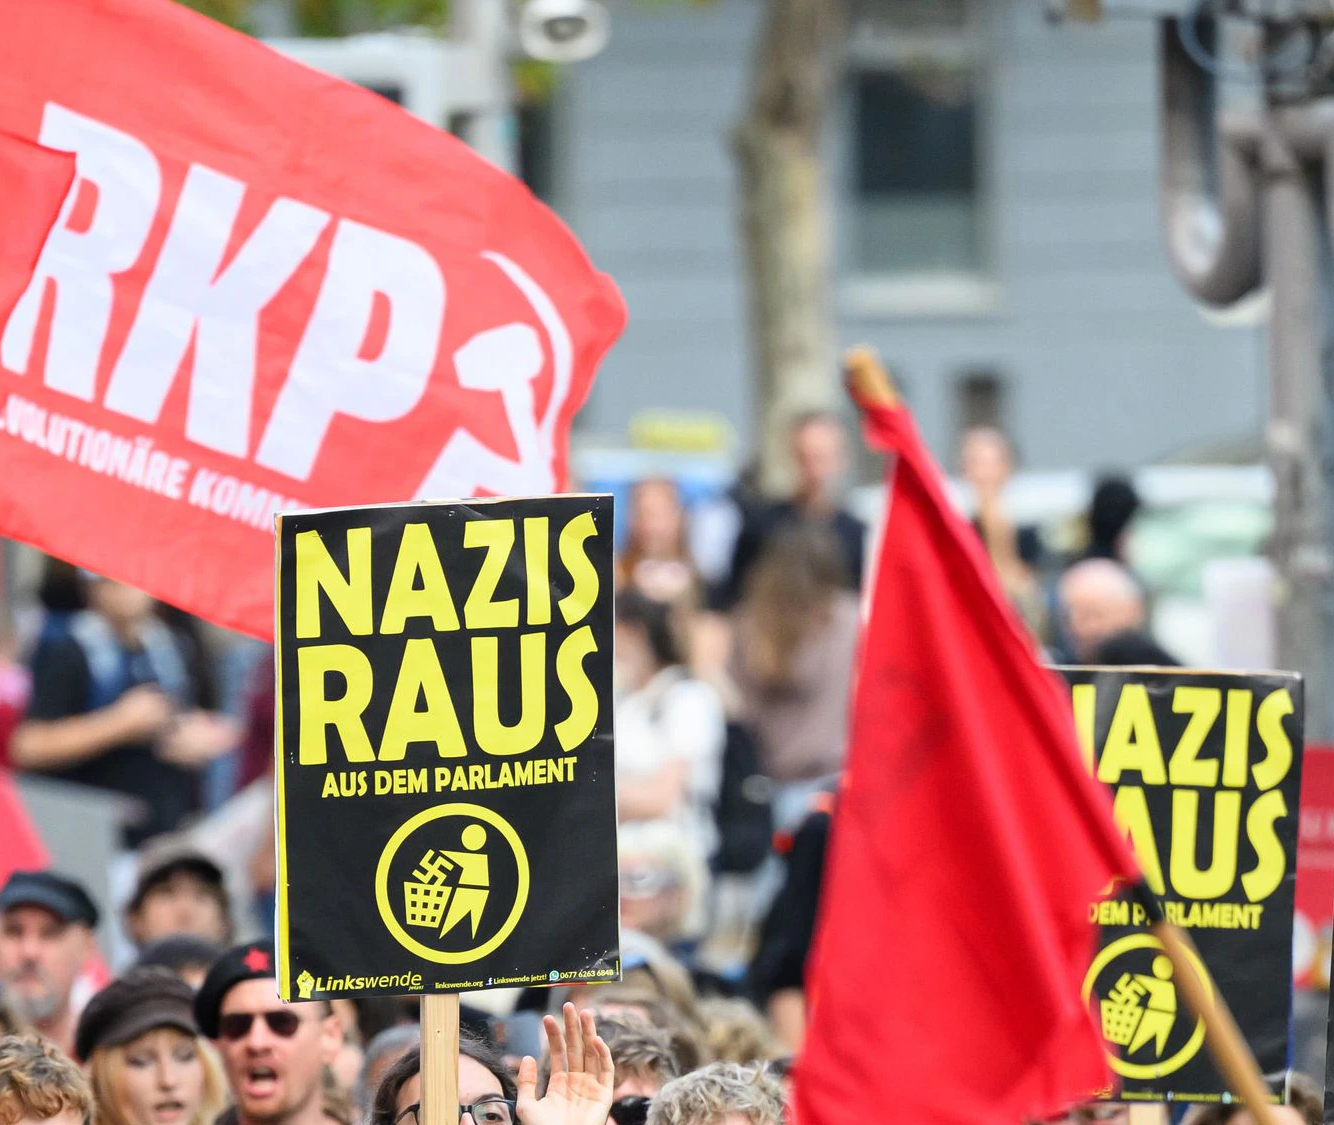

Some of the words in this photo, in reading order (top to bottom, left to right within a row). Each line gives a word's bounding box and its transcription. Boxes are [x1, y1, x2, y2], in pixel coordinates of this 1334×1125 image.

[0, 101, 447, 482] RKP
[295, 512, 600, 639] NAZIS
[297, 626, 599, 766] RAUS
[321, 771, 368, 799] AUS
[375, 766, 429, 796] DEM
[434, 757, 578, 792] PARLAMENT
[1113, 786, 1288, 903] AUS
[1132, 901, 1265, 931] PRLAMENT
[315, 971, 422, 992] Linkswende
[435, 979, 484, 989] linkswende.org
[493, 975, 530, 985] Linkswende
[530, 973, 548, 983] jetzt!
[559, 971, 578, 979] 0677
[578, 970, 596, 978] 6263
[596, 968, 614, 977] 6848
